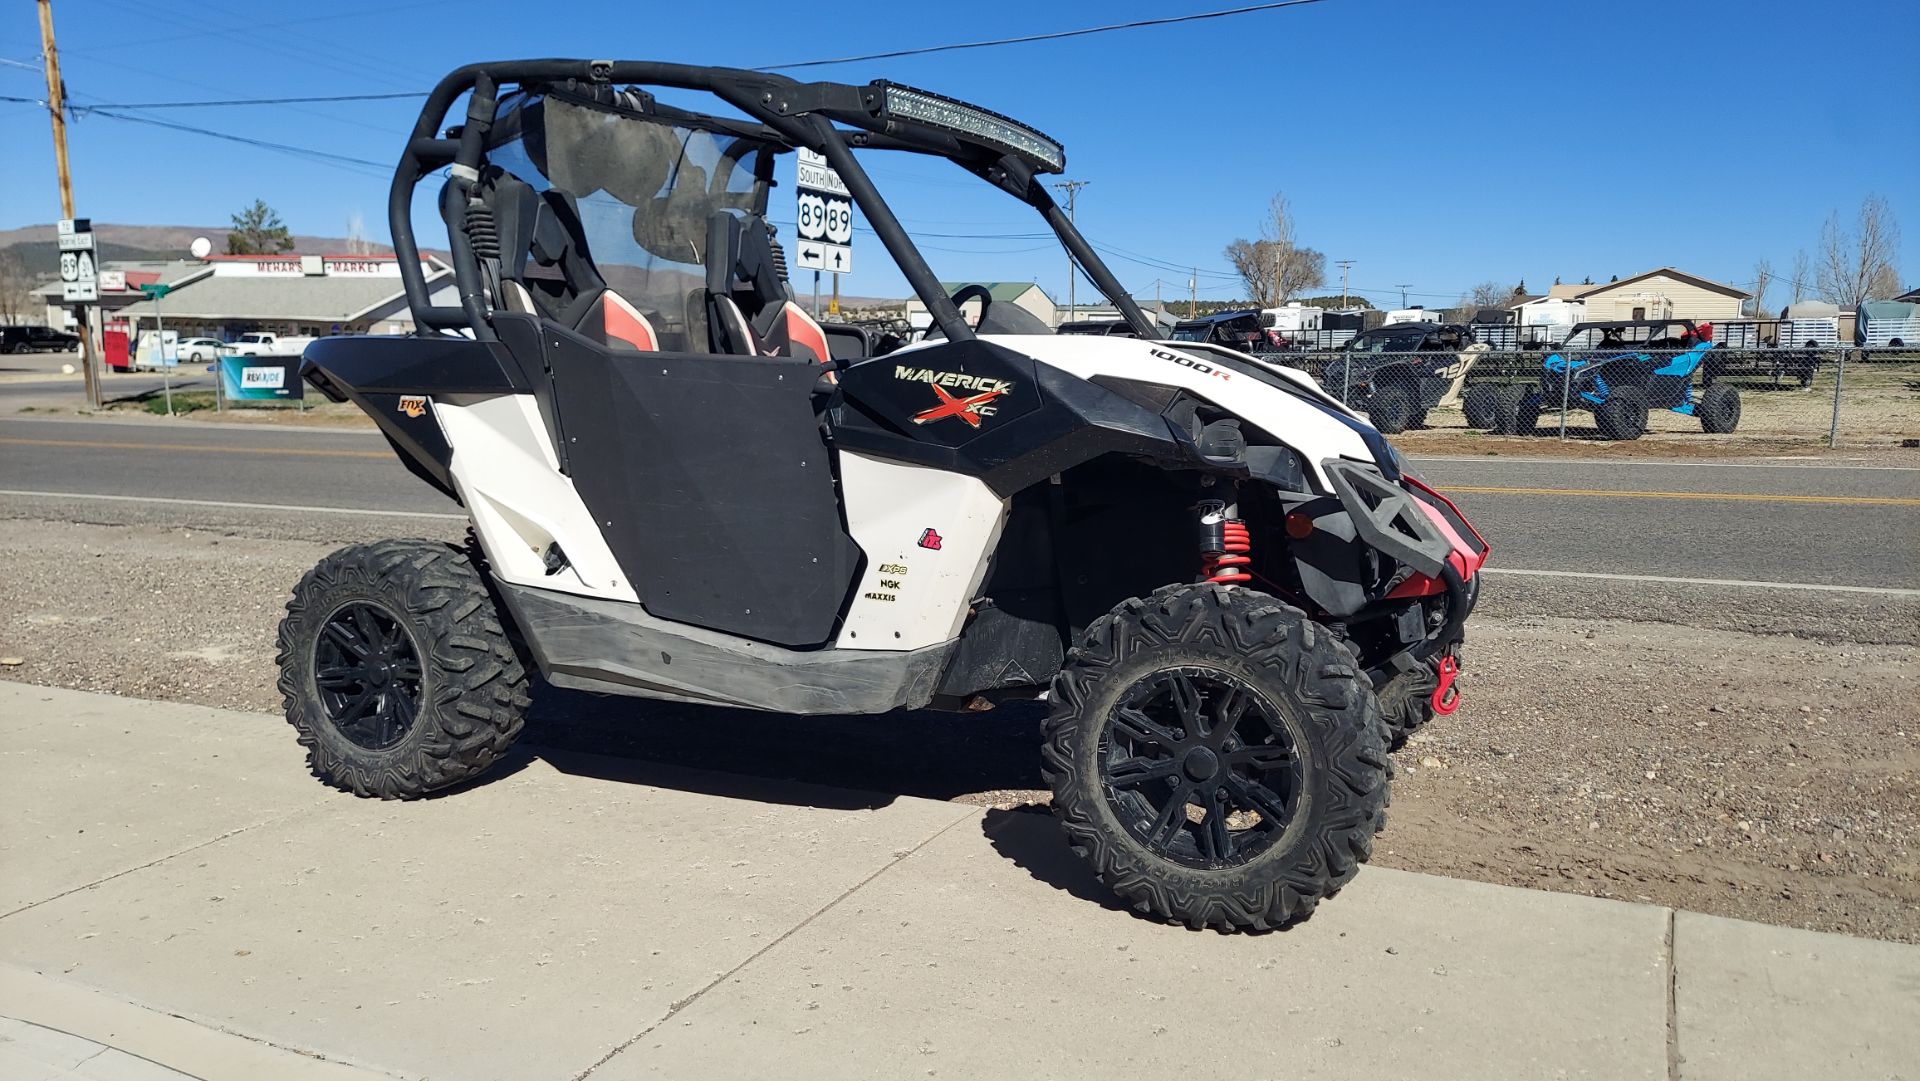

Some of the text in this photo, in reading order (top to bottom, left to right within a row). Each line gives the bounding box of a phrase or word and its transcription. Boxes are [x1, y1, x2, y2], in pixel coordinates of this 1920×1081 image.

[799, 166, 825, 186] SOUTH
[827, 172, 847, 191] NOR
[801, 203, 823, 228] 89
[828, 208, 850, 232] 89
[63, 258, 76, 274] 89
[334, 262, 381, 273] MARKET
[1150, 348, 1232, 381] 1000R
[895, 365, 1012, 395] MAVERICK
[401, 399, 423, 411] FOX
[880, 579, 901, 590] NGK
[864, 592, 896, 602] MAXXIS
